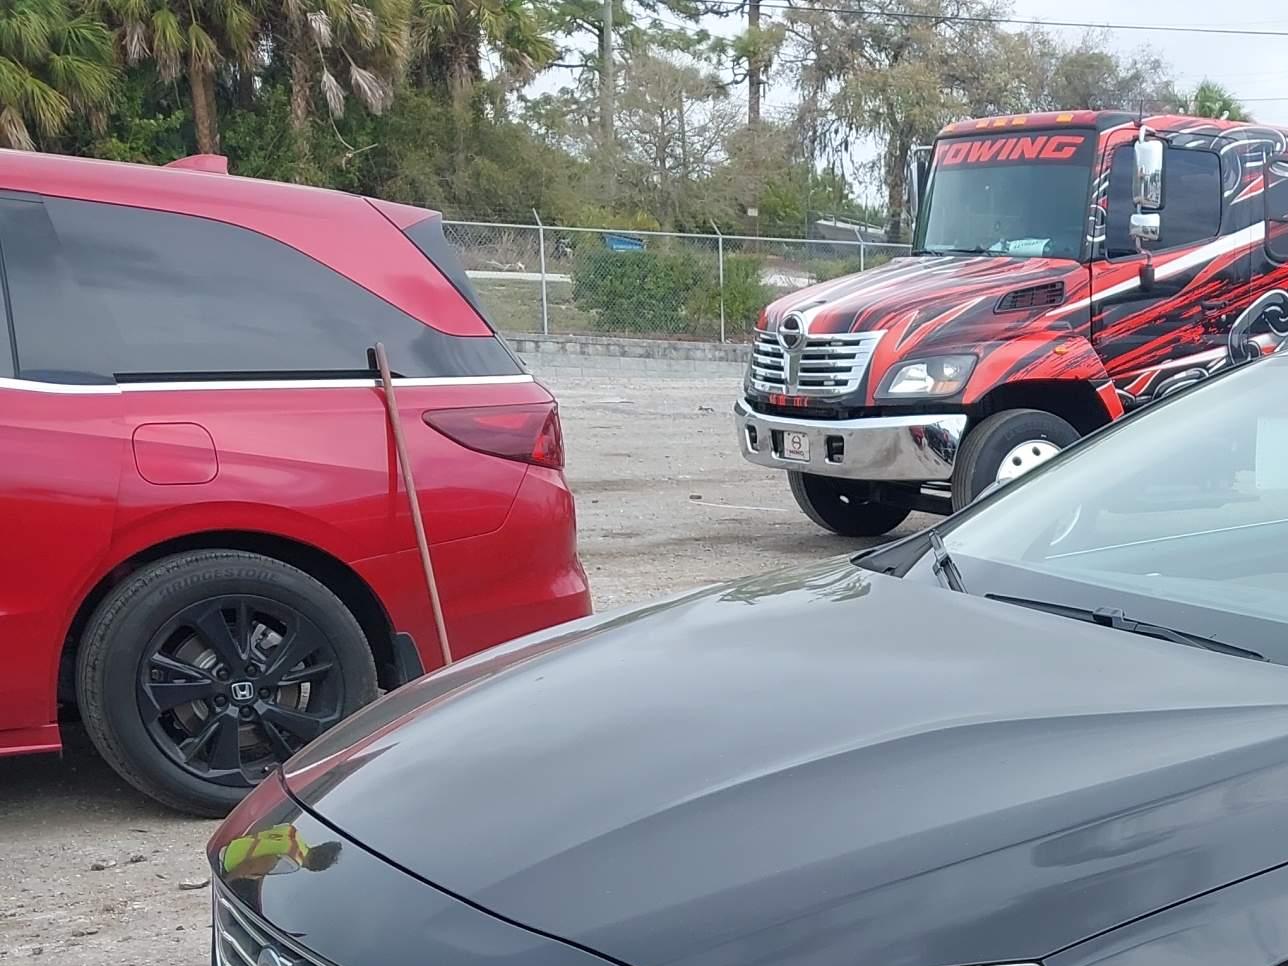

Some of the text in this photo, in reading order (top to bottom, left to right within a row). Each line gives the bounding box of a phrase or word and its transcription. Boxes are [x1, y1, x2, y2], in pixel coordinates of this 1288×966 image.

[937, 134, 1086, 165] TOWING
[788, 449, 805, 457] HINO
[159, 566, 281, 599] BRIDGESTONE
